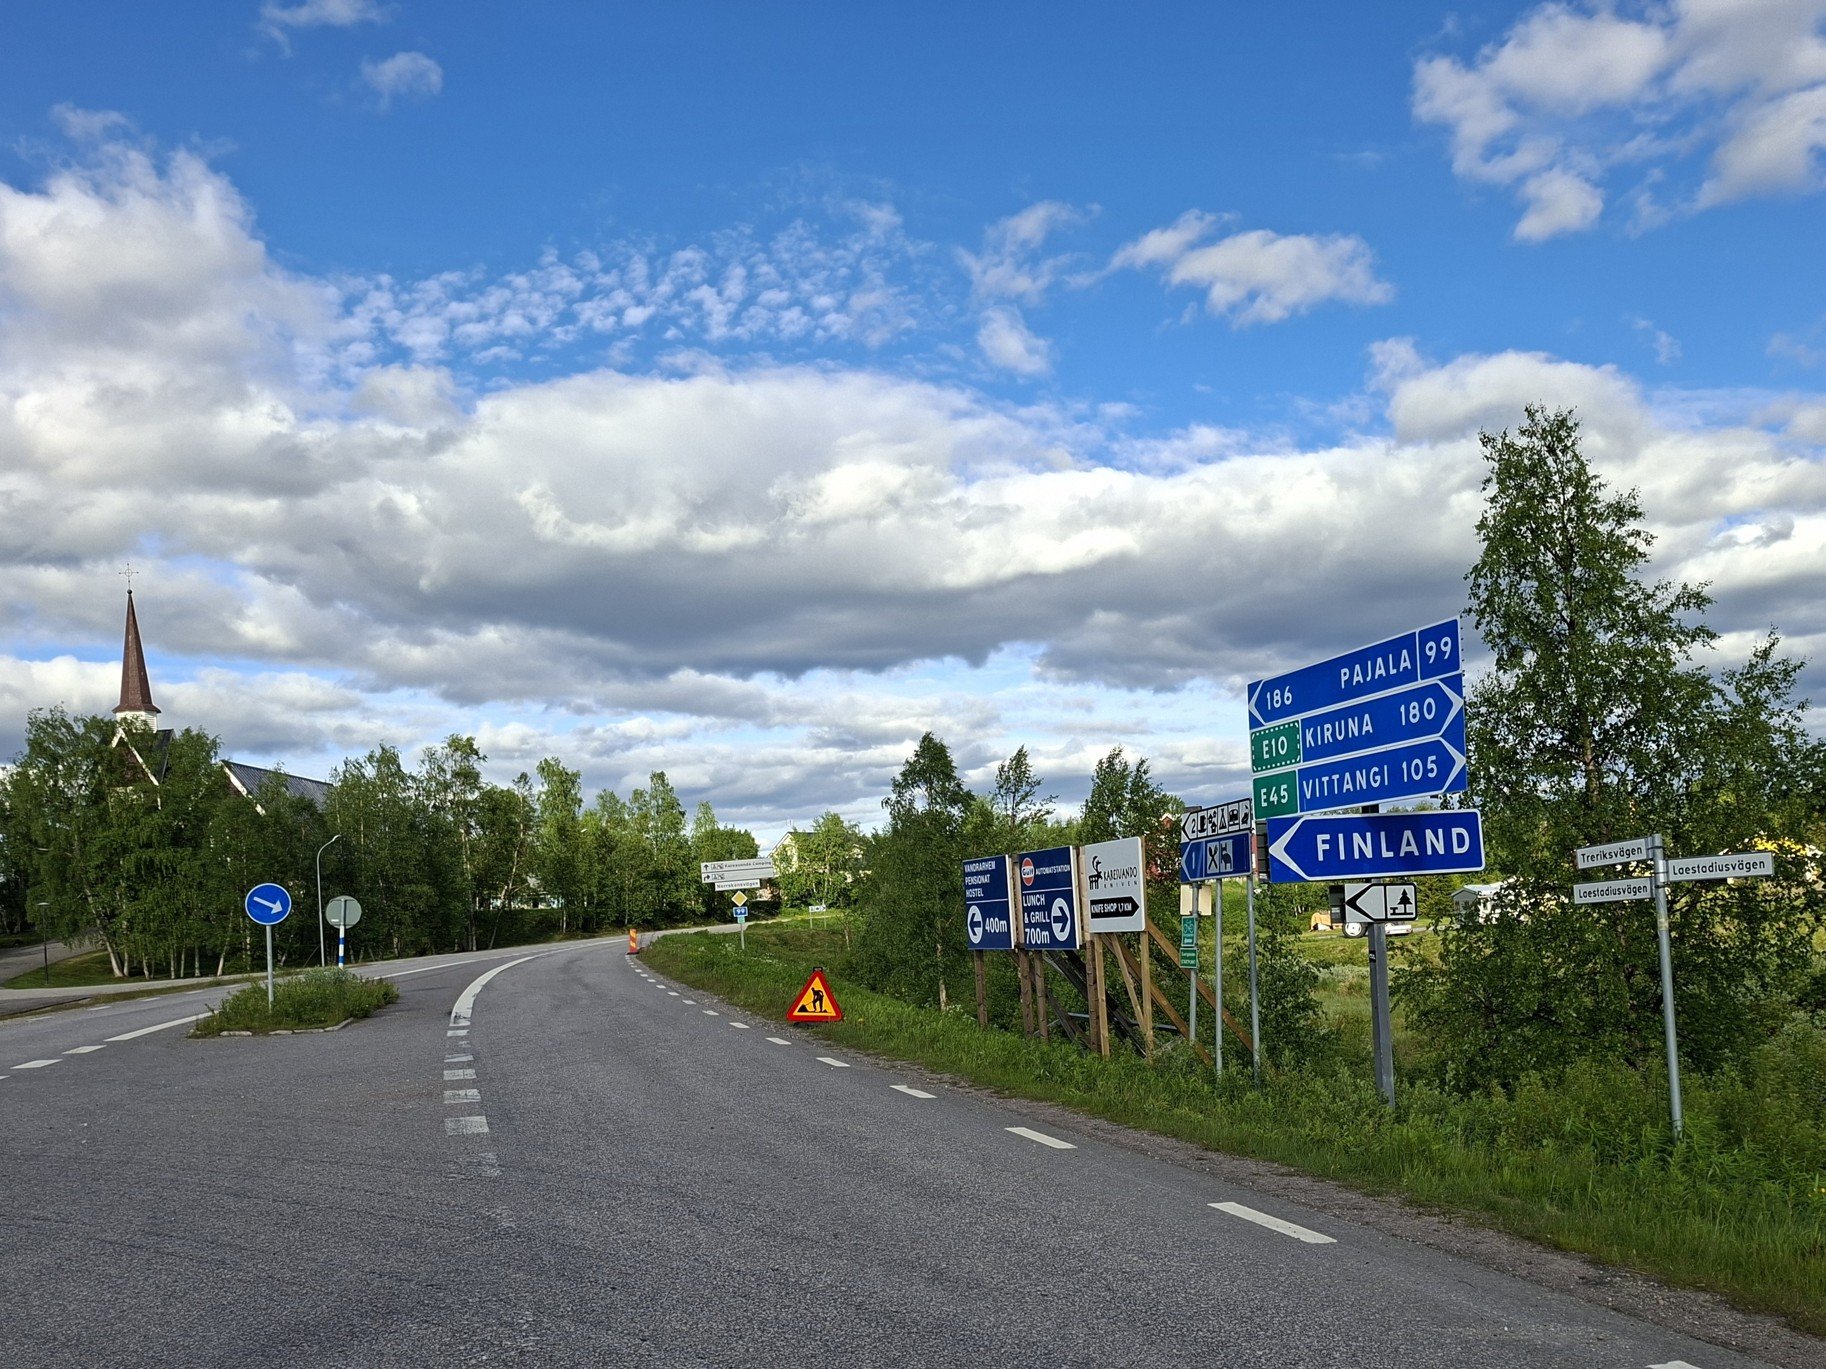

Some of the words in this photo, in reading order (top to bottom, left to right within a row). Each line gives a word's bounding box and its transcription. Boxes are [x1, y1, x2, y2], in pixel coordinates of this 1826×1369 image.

[1266, 686, 1293, 710] 186
[1340, 649, 1412, 689] PAJALA
[1425, 636, 1452, 664] 99
[1262, 736, 1288, 760] E10
[1305, 713, 1373, 748] KIRUNA
[1399, 697, 1436, 726] 180
[1260, 784, 1288, 807] E45
[1302, 764, 1389, 800] VITTANGI
[1402, 755, 1438, 782] 105
[1191, 818, 1196, 834] 2
[1316, 827, 1470, 861] FINLAND
[1580, 845, 1643, 863] Treriksvägen
[1035, 864, 1071, 876] AUTOMATSTATION
[1672, 859, 1766, 876] Laestadiusvägen
[965, 874, 990, 885] PENSIONAT
[965, 888, 984, 898] HOSTEL
[1578, 883, 1648, 899] Laestadiusvägen
[1022, 894, 1045, 907] LUNCH
[1091, 903, 1104, 914] KNIFE
[1104, 902, 1117, 912] SHOP
[985, 917, 1008, 933] 400m
[1024, 913, 1029, 923] &
[1030, 910, 1050, 924] GRILL
[1025, 928, 1050, 945] 700m
